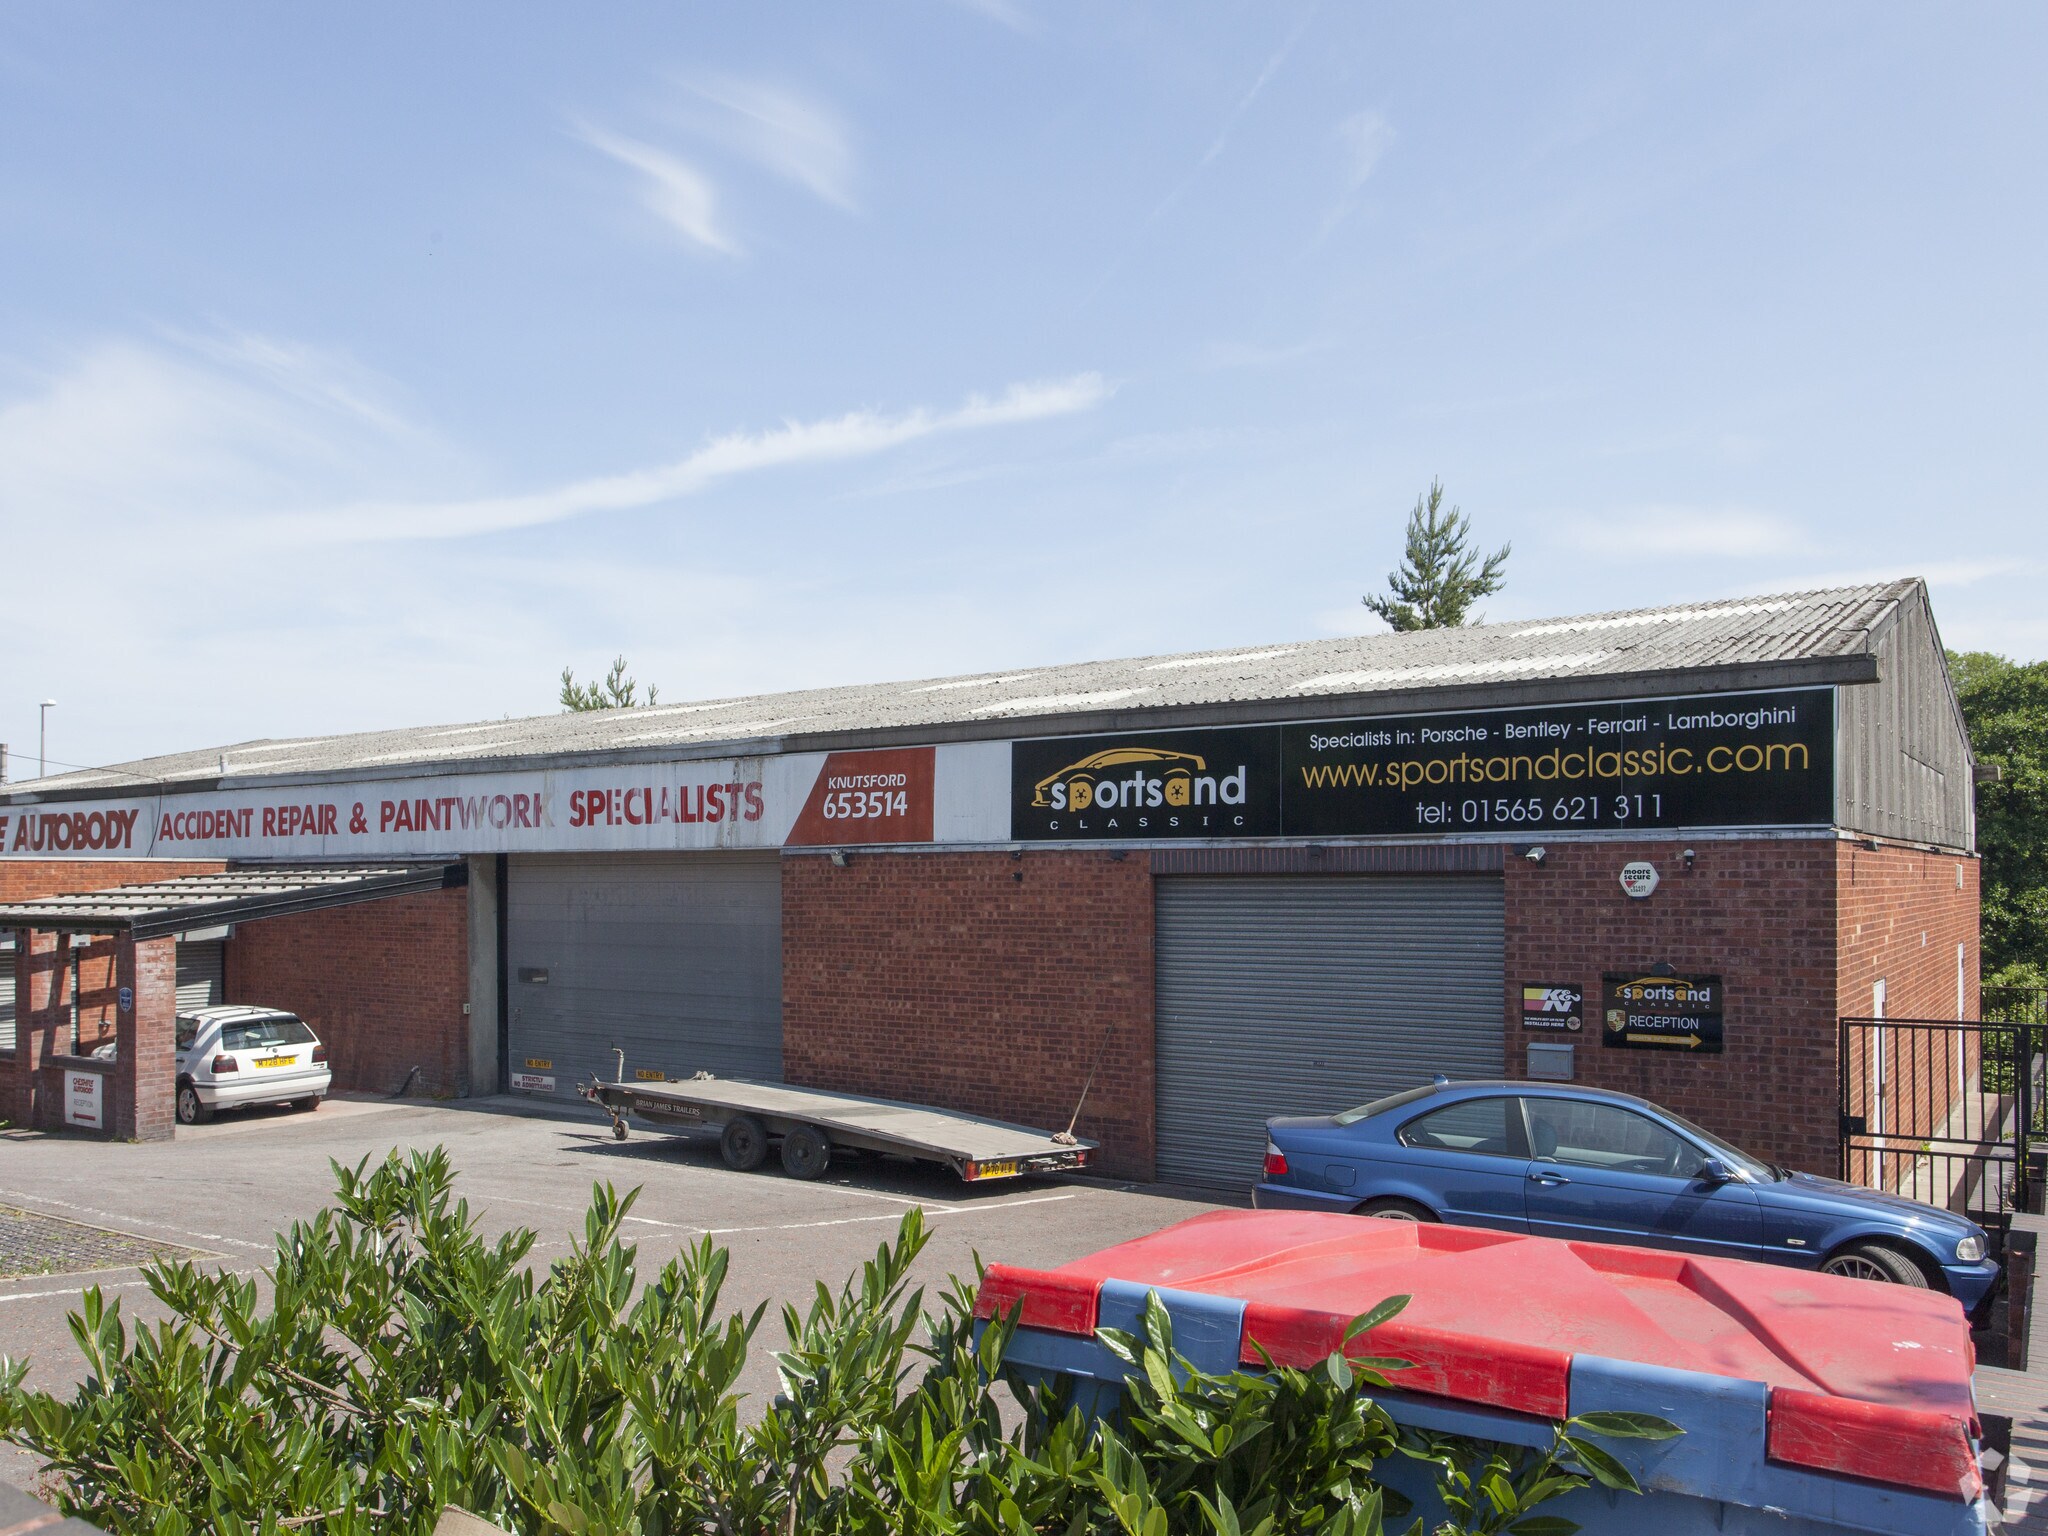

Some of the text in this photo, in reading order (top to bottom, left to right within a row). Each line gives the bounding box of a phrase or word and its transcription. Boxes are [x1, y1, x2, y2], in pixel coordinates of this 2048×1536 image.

[1309, 731, 1391, 751] Specialists
[1396, 728, 1414, 745] in:
[1421, 724, 1487, 744] Porsche
[1505, 720, 1571, 743] Bentley
[1588, 716, 1647, 735] Ferrari
[1668, 706, 1796, 732] Lamborghini
[1301, 741, 1809, 792] www.sportsandclassic.com
[828, 773, 906, 790] KNUTSFORD
[1051, 765, 1246, 812] sportsand
[159, 781, 765, 841] ACCIDENT REPAIR & PAINTWORK SPECIALISTS
[823, 791, 907, 819] 653514
[1416, 793, 1662, 824] tel: 01565 621 311
[12, 809, 139, 852] AUTOBODY
[1049, 815, 1244, 831] CLASSIC
[1623, 986, 1711, 1002] sportsand
[1629, 1015, 1700, 1030] RECEPTION
[535, 1060, 551, 1068] ENTRY
[646, 1071, 663, 1080] ENTRY
[636, 1099, 700, 1116] BRIAN JAMES TRAILERS
